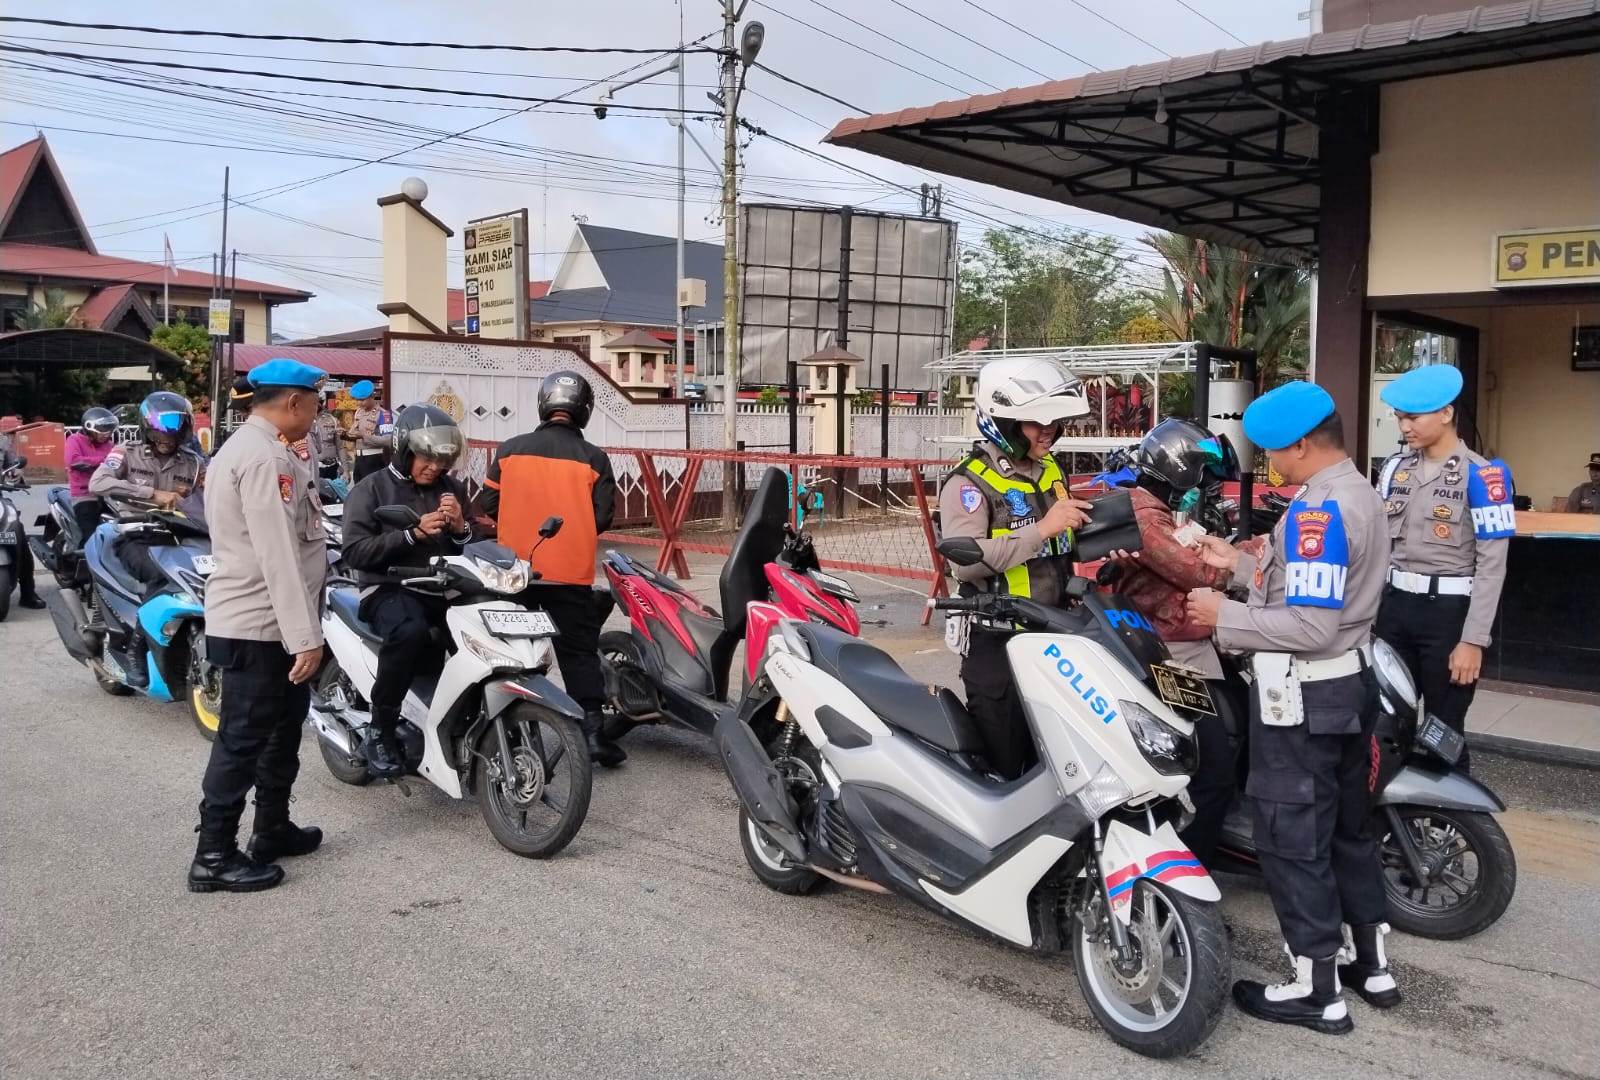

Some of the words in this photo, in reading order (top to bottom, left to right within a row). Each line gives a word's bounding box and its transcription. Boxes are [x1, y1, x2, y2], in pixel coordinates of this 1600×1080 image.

[465, 251, 489, 267] KAMI
[492, 247, 513, 262] SIAP
[466, 264, 495, 275] MELAYANI
[497, 260, 513, 271] ANDA
[480, 279, 494, 292] 110
[1433, 489, 1464, 500] POLRI
[1010, 517, 1035, 529] MUFTI
[1470, 503, 1516, 533] PRO
[1285, 561, 1348, 601] ROV
[484, 611, 501, 623] KB
[1043, 643, 1118, 725] POLISI
